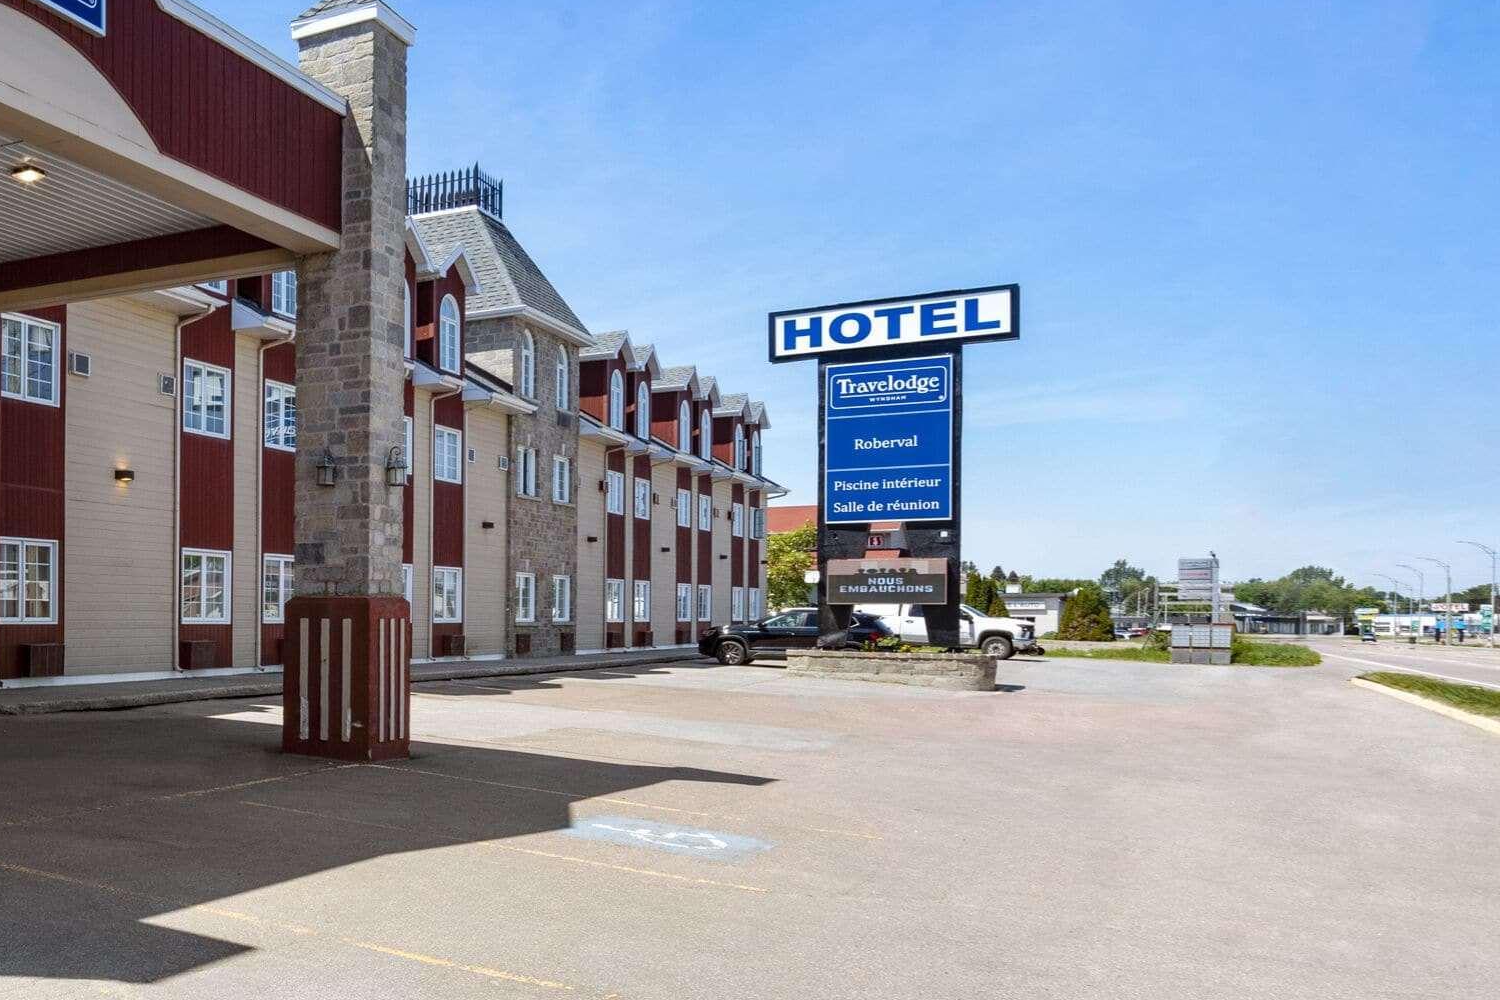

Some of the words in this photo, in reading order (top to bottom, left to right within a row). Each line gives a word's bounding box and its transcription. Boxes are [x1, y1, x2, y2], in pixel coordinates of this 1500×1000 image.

[783, 298, 1001, 351] HOTEL
[836, 375, 940, 394] Travelodge
[854, 435, 919, 450] Roberval
[834, 480, 880, 491] Piscine
[882, 478, 942, 489] intérieur
[833, 501, 864, 513] Salle
[867, 500, 884, 512] de
[886, 499, 940, 511] réunion
[867, 577, 904, 585] NOUS
[839, 585, 934, 593] EMBAUCHONS
